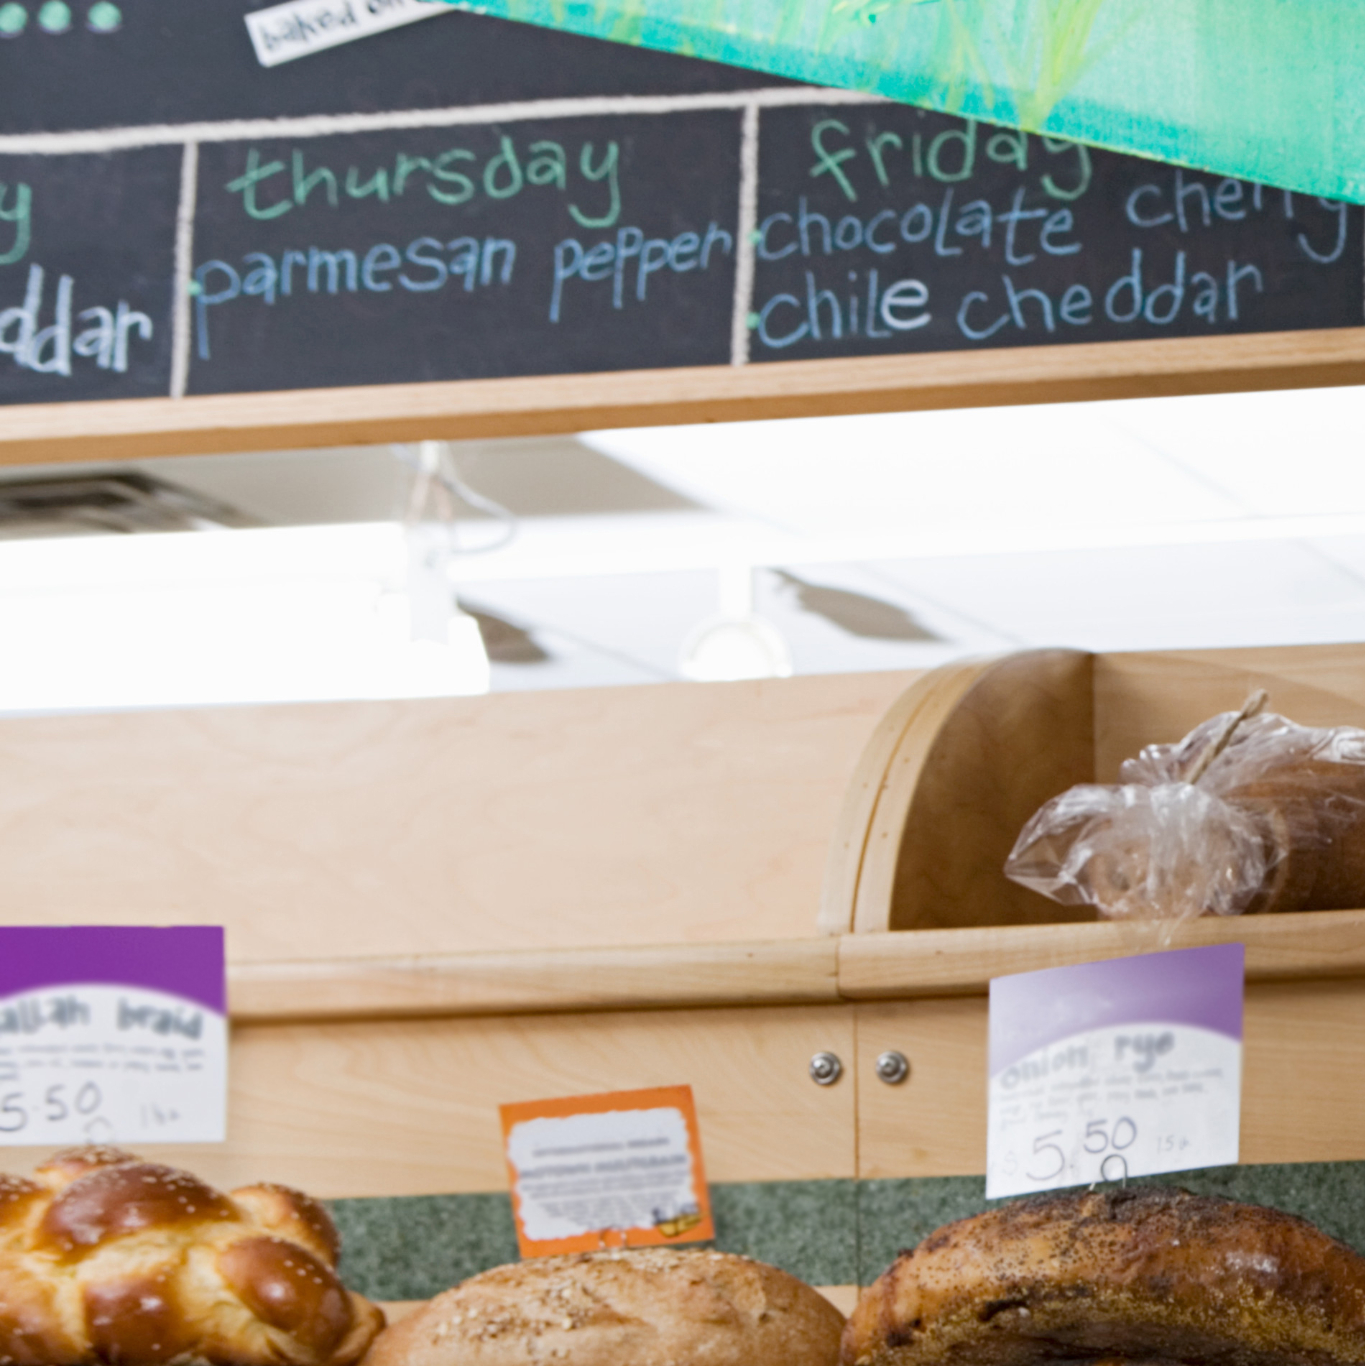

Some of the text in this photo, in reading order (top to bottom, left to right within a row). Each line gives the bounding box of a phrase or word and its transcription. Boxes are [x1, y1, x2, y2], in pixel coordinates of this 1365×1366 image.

[226, 136, 622, 228] thursday
[809, 110, 1093, 201] friday
[758, 187, 1082, 266] chocolate
[195, 223, 732, 360] parmesan pepper
[758, 247, 1263, 349] chile cheddar
